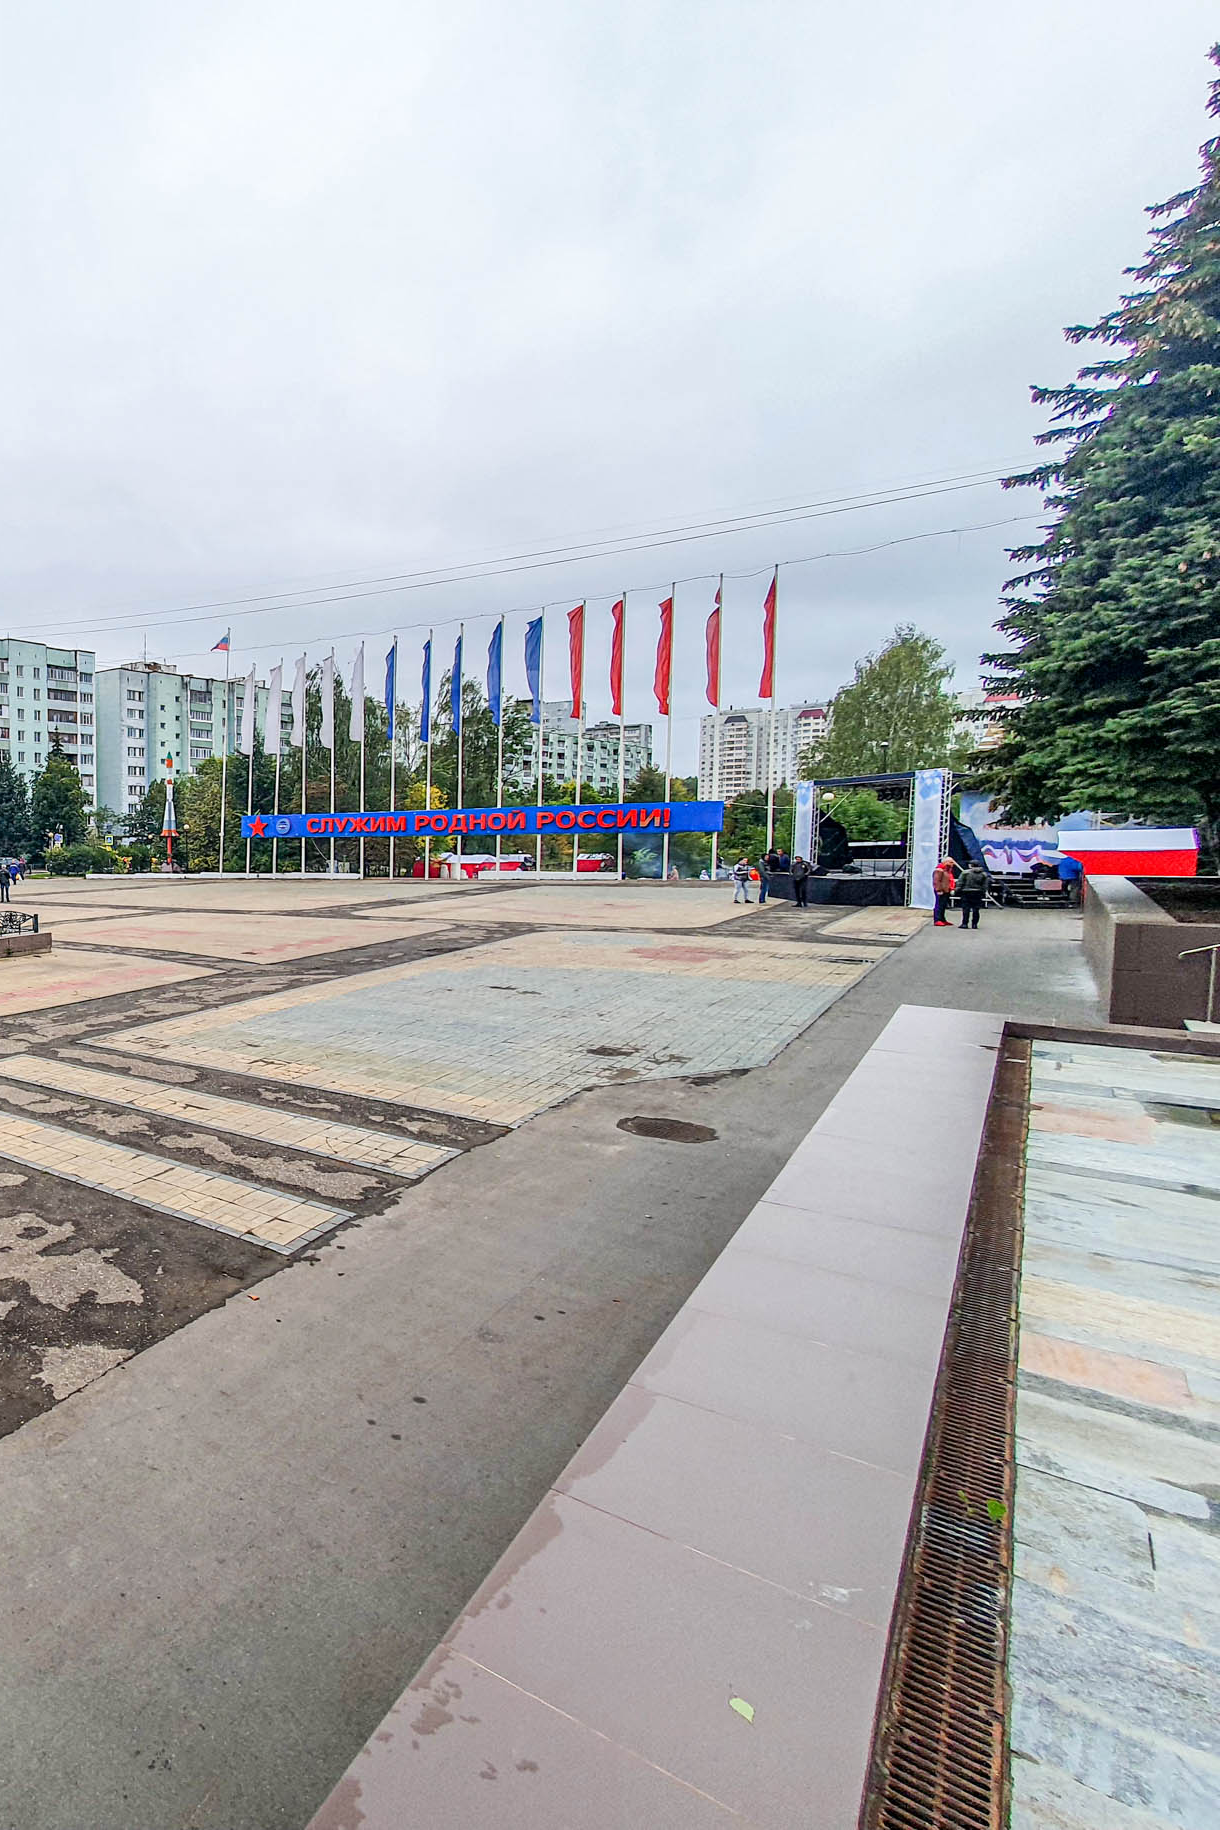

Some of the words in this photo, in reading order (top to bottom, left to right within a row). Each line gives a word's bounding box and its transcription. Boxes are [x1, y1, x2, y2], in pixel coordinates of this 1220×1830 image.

[306, 815, 407, 834] СЛУЖИМ
[414, 810, 526, 833] РОДНОЙ
[536, 808, 671, 829] РОССИИ!
